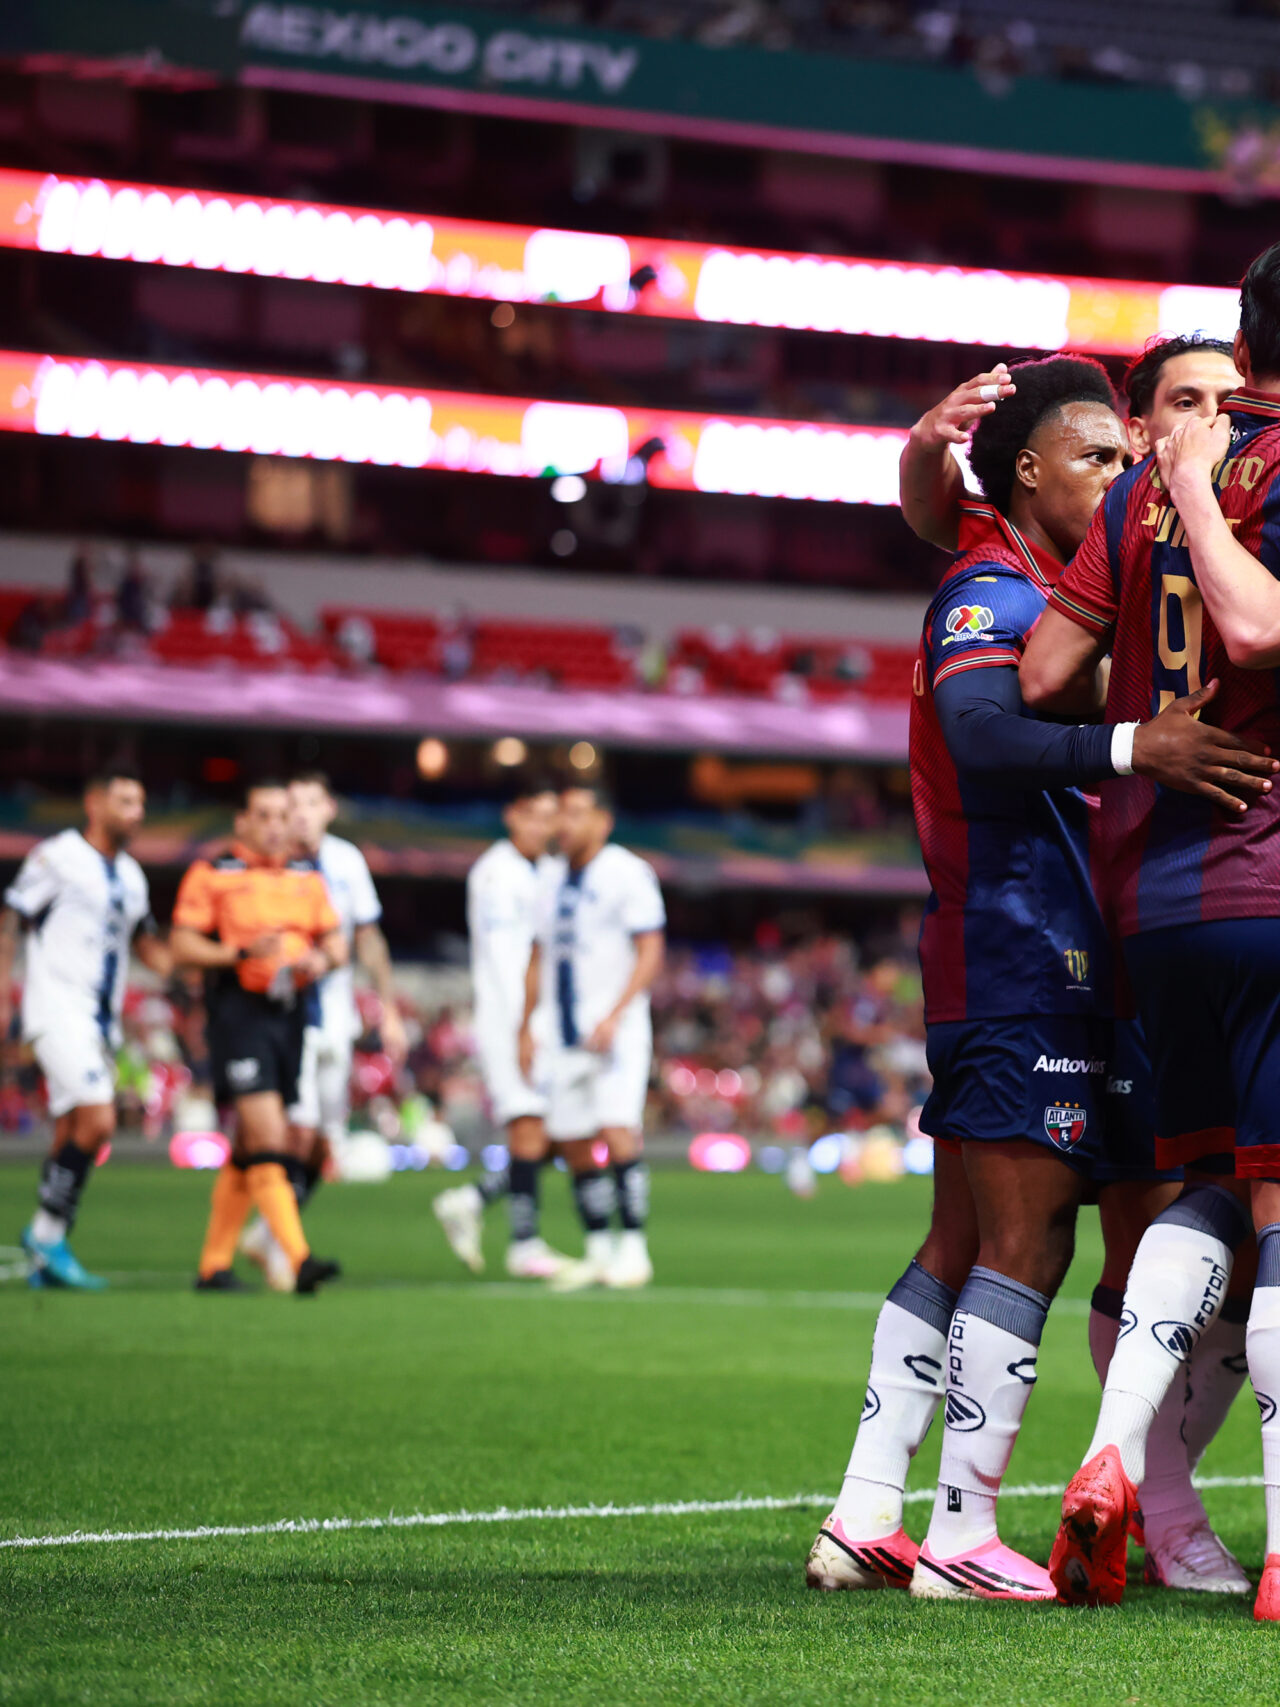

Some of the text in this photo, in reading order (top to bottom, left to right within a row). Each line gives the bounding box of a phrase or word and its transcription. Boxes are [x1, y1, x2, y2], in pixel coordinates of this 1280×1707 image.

[481, 28, 640, 95] CITY
[1158, 574, 1203, 720] 9
[1048, 1110, 1083, 1122] ATLANTE
[1194, 1263, 1229, 1329] FOTON
[949, 1310, 969, 1387] FOTON
